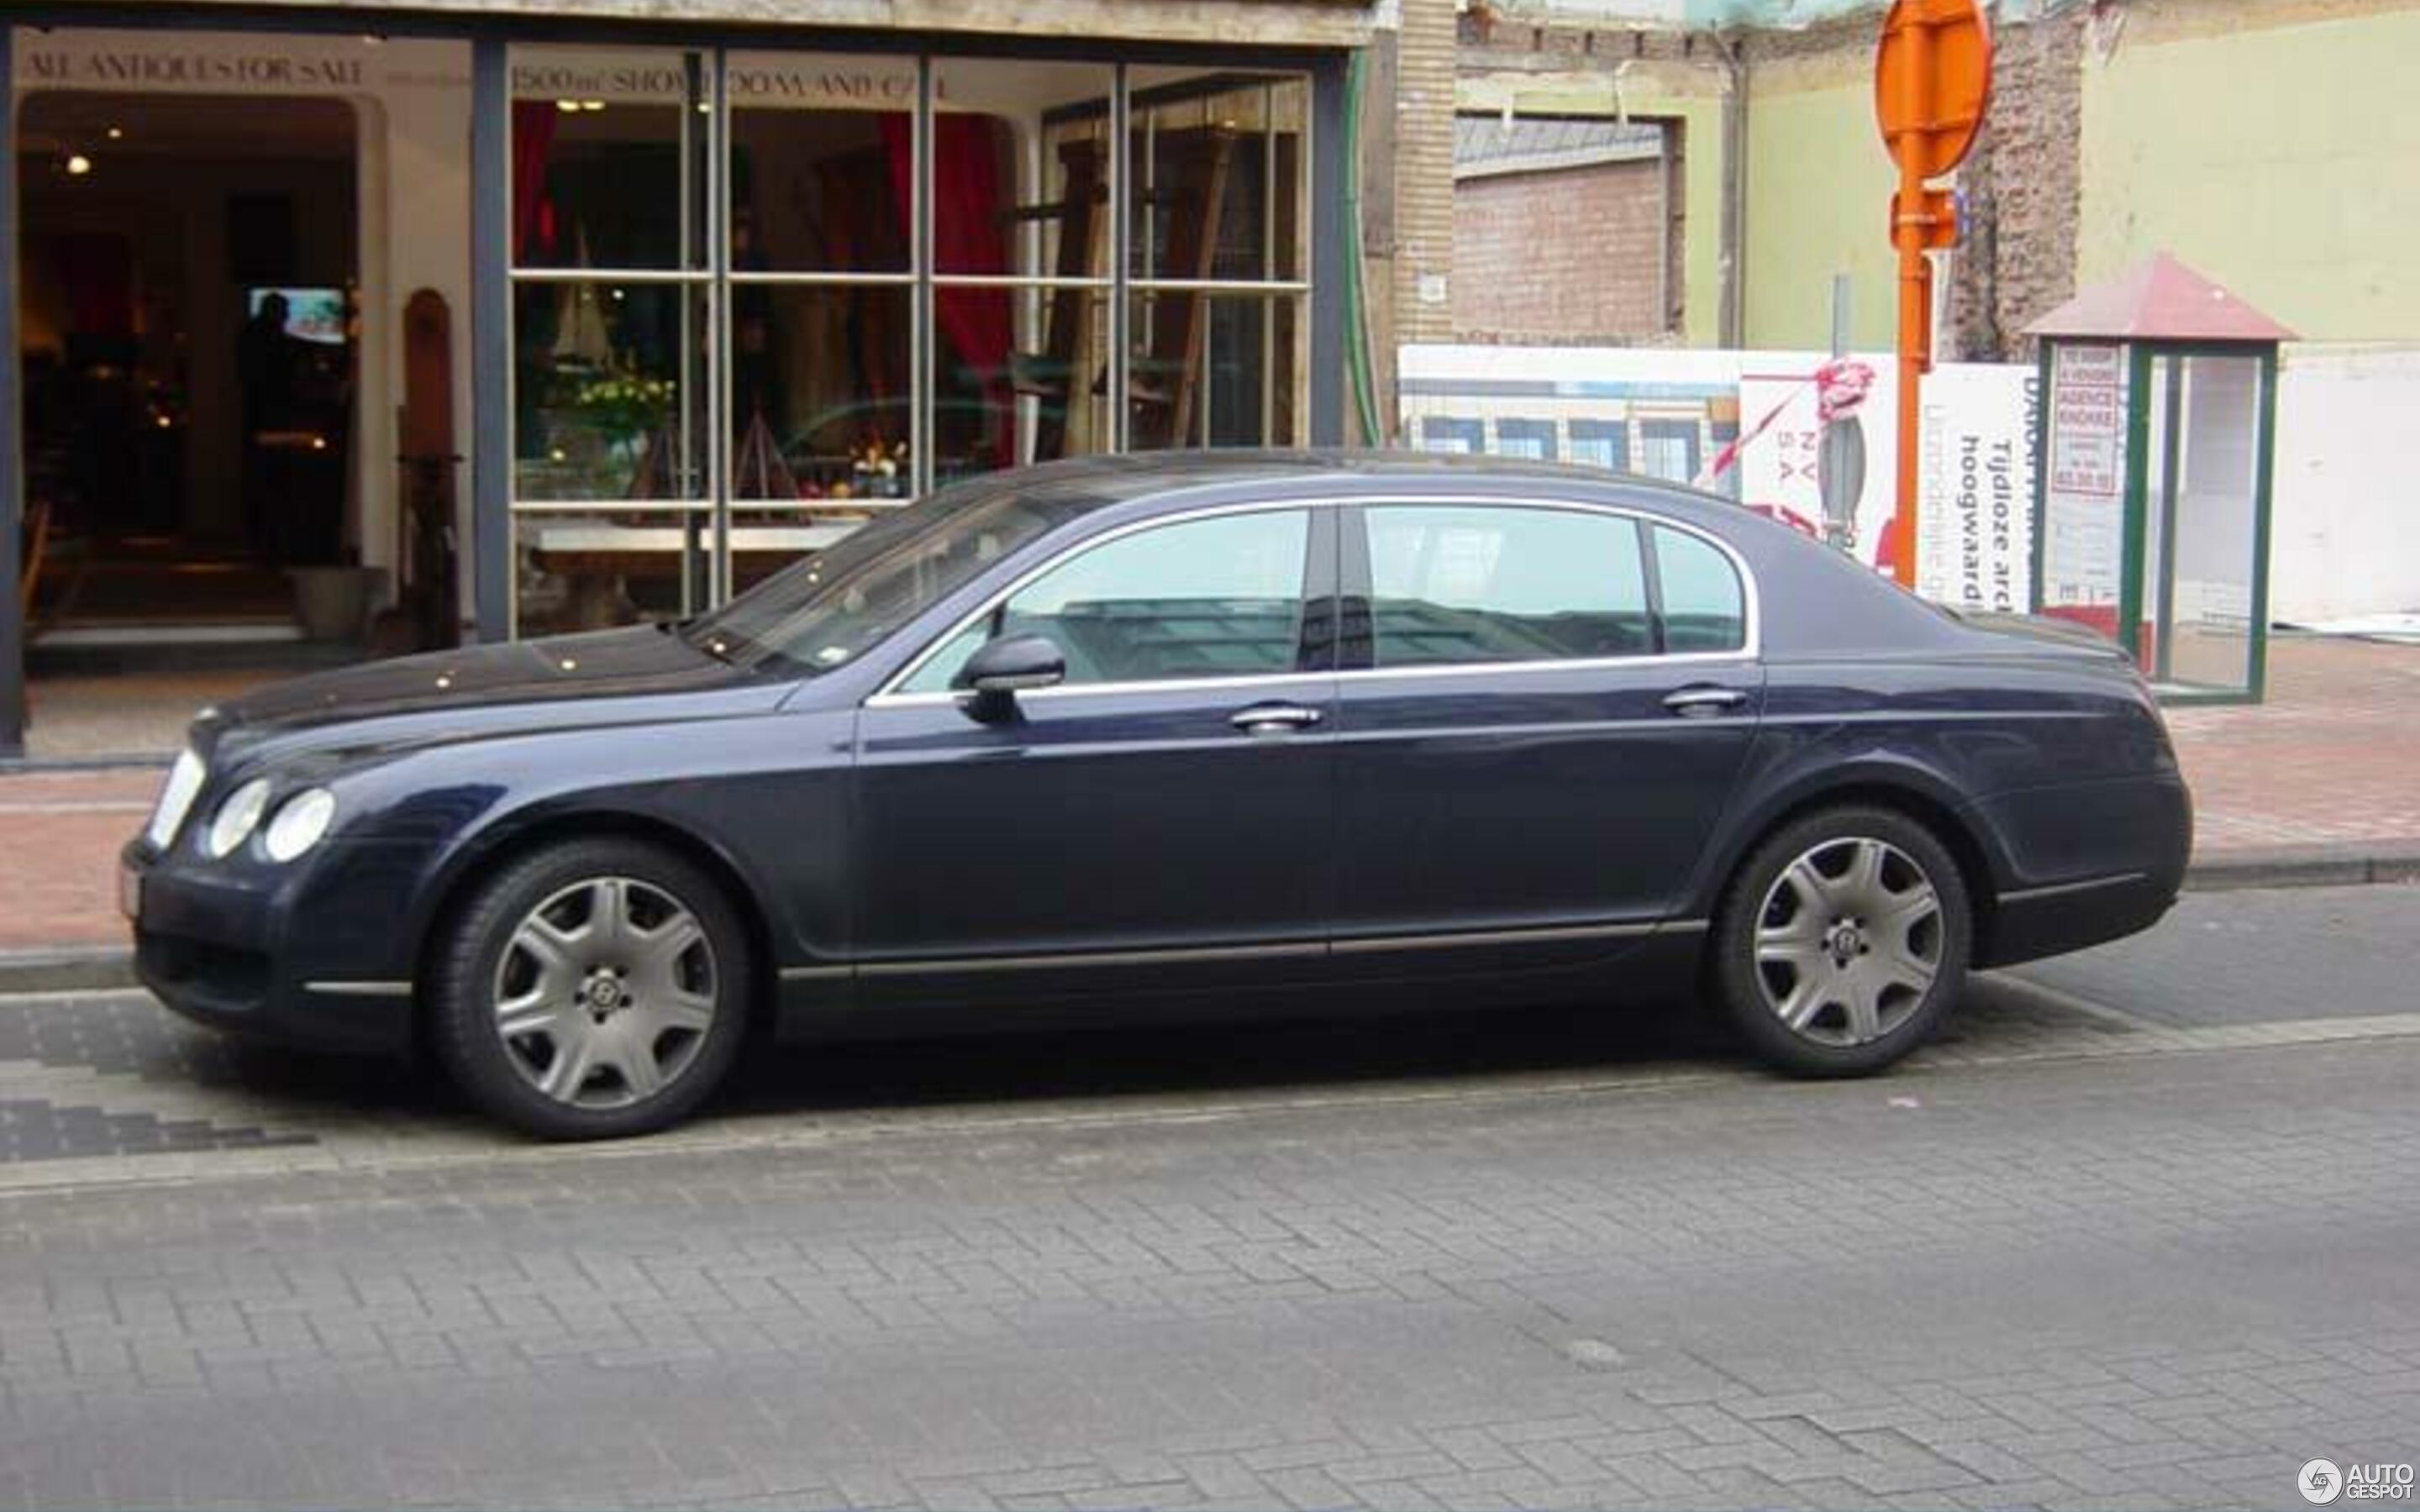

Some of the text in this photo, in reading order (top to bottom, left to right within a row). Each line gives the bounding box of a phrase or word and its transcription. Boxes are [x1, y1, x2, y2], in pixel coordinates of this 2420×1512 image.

[28, 53, 69, 79] ALL
[87, 54, 232, 82] ANTIQUES
[238, 57, 292, 84] FOR
[299, 60, 362, 85] SALE
[614, 67, 807, 97] SHOWOOM
[818, 73, 872, 97] AND
[1986, 438, 2012, 551] Tijdloze
